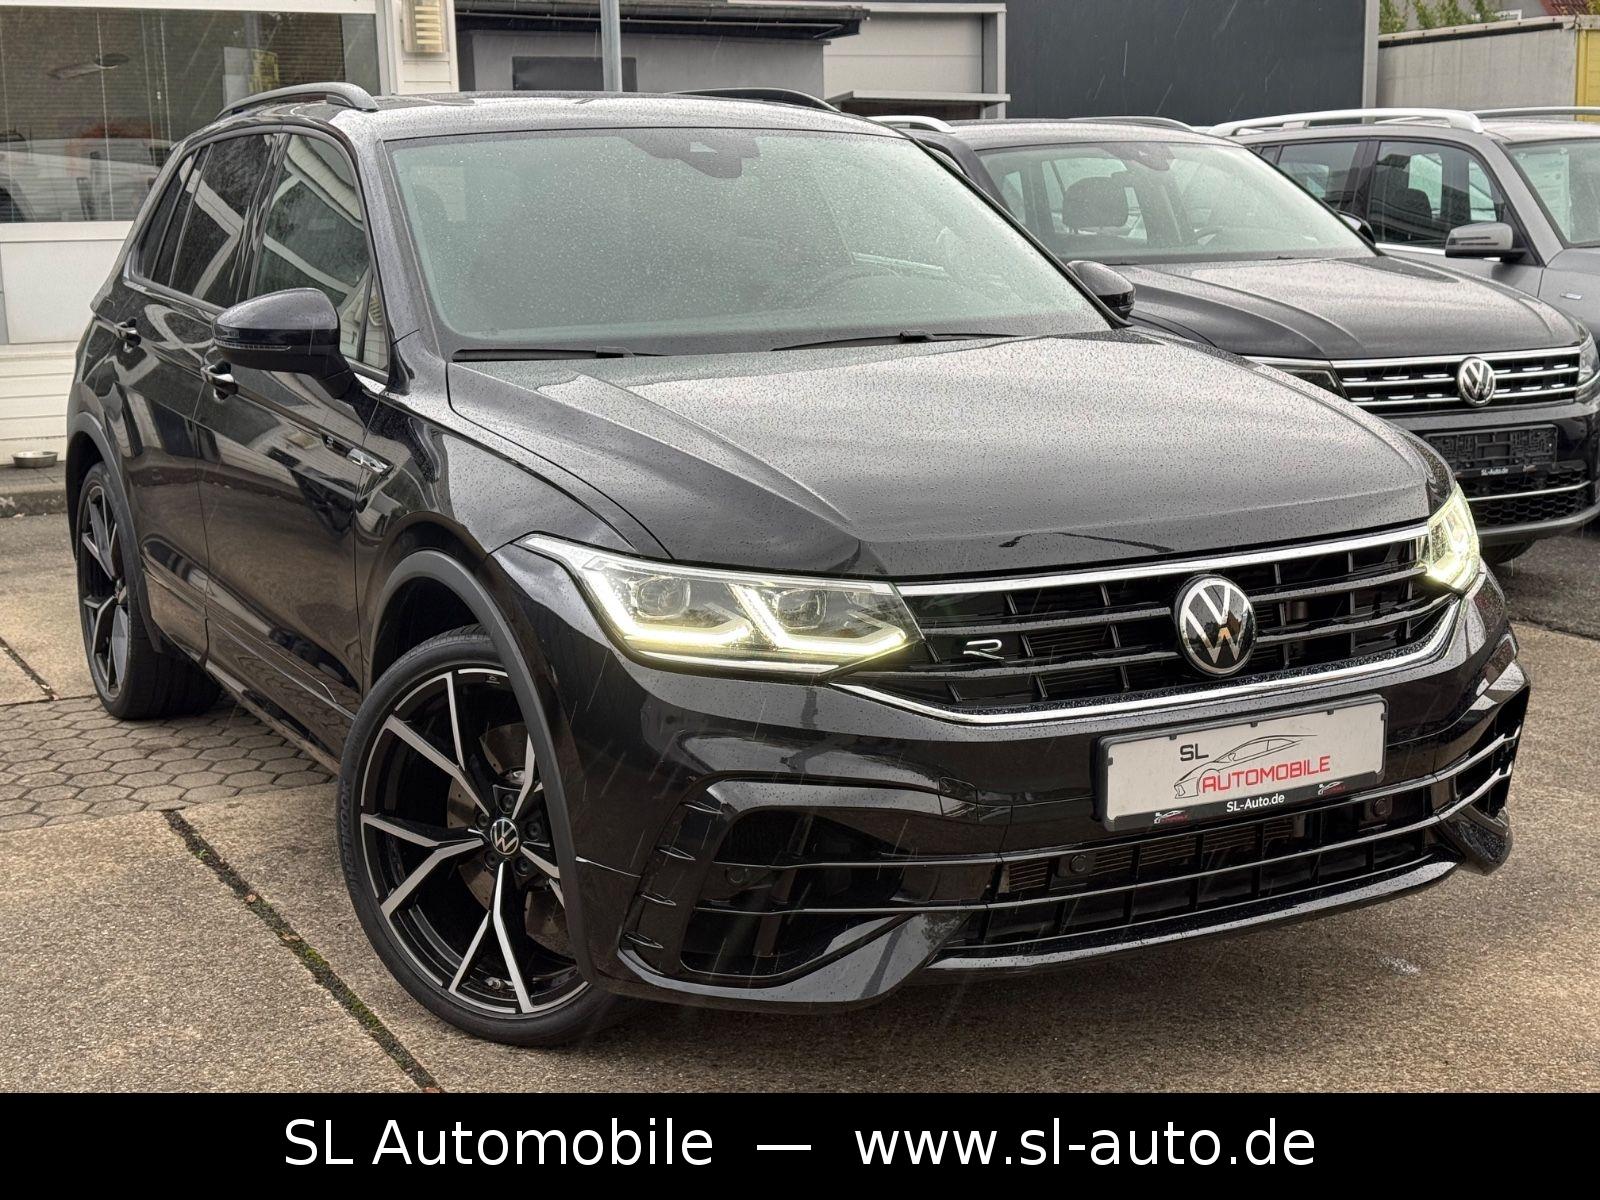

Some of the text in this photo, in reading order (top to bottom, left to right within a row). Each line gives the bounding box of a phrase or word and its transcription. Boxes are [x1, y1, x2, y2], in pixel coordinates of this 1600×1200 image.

[1178, 575, 1255, 675] VW
[1179, 743, 1209, 762] SL
[1202, 755, 1332, 794] AUTOMOBILE
[1226, 793, 1285, 813] SL-Auto.de
